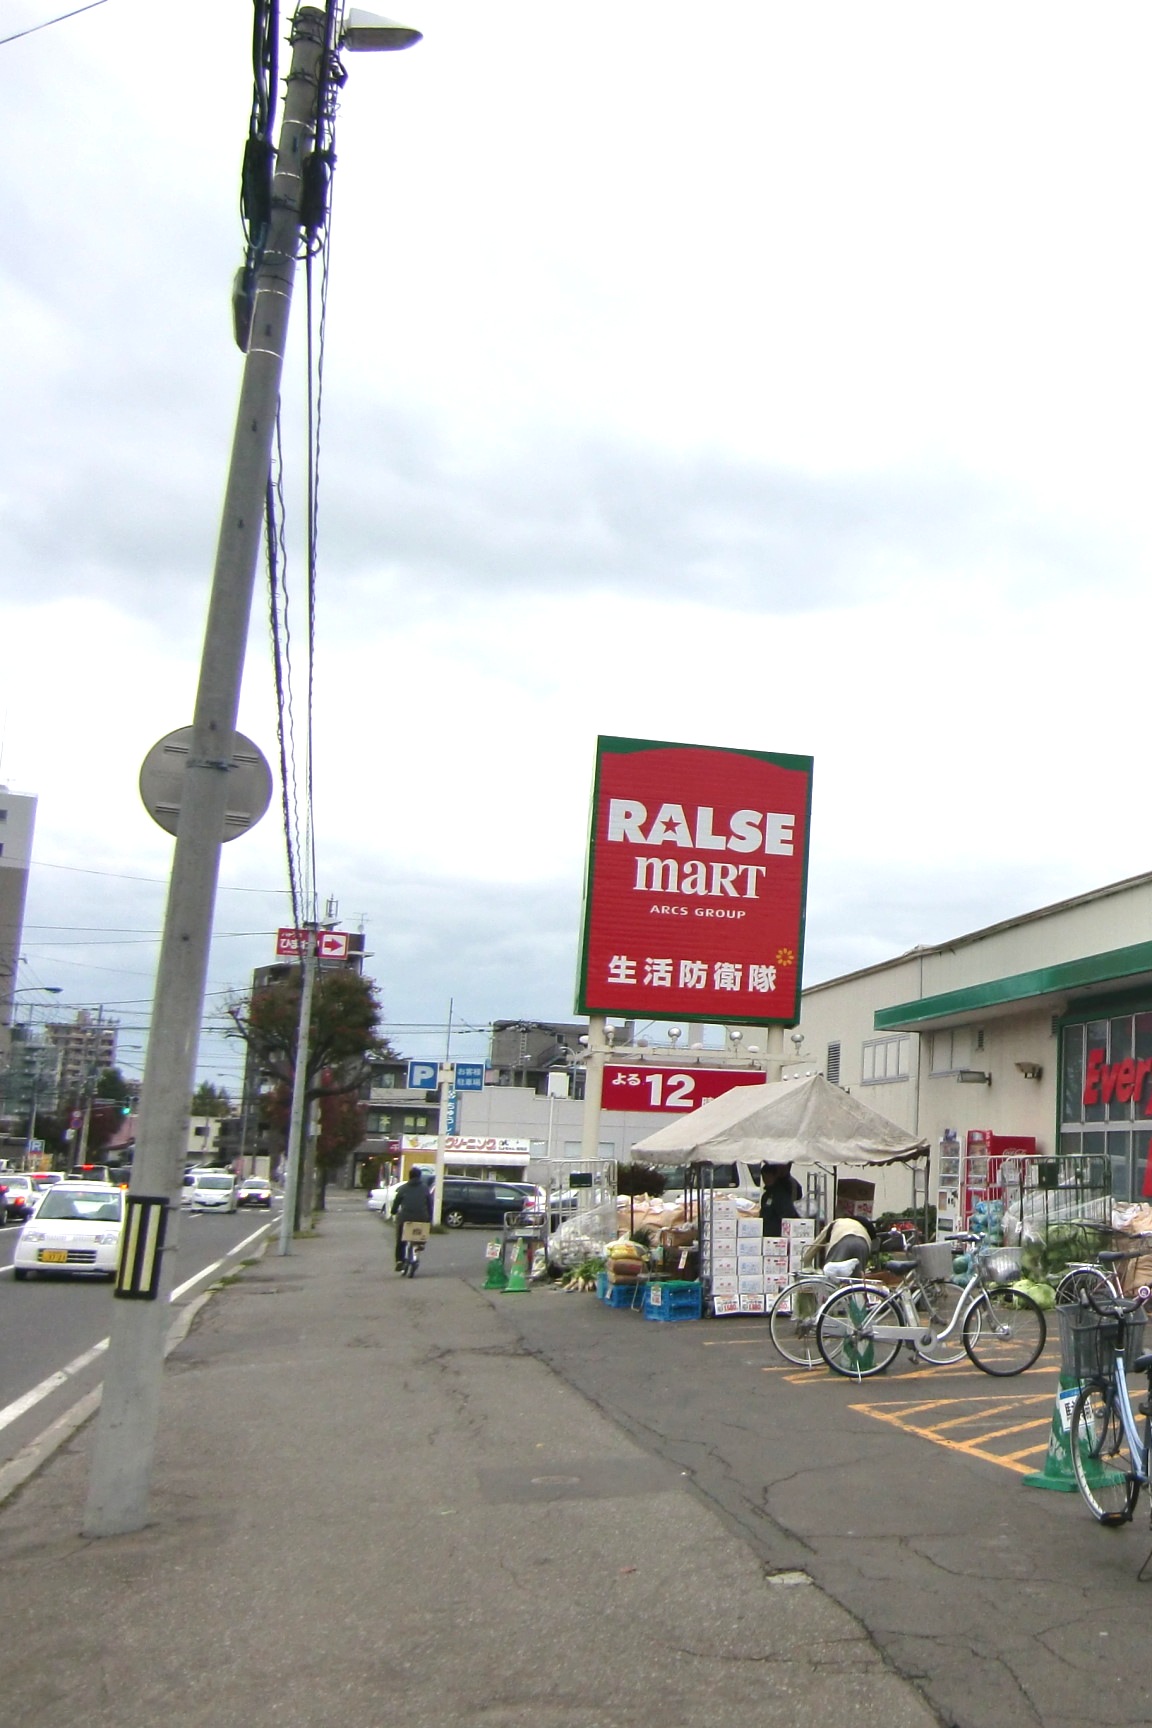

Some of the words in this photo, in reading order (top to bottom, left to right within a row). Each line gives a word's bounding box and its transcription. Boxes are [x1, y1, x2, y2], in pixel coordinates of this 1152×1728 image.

[607, 798, 796, 856] RALSE
[650, 904, 689, 916] ARCS
[694, 907, 746, 919] GROUP
[607, 955, 777, 993] 生活防衛隊
[413, 1065, 435, 1087] P
[612, 1072, 640, 1086] よる
[646, 1073, 696, 1107] 12
